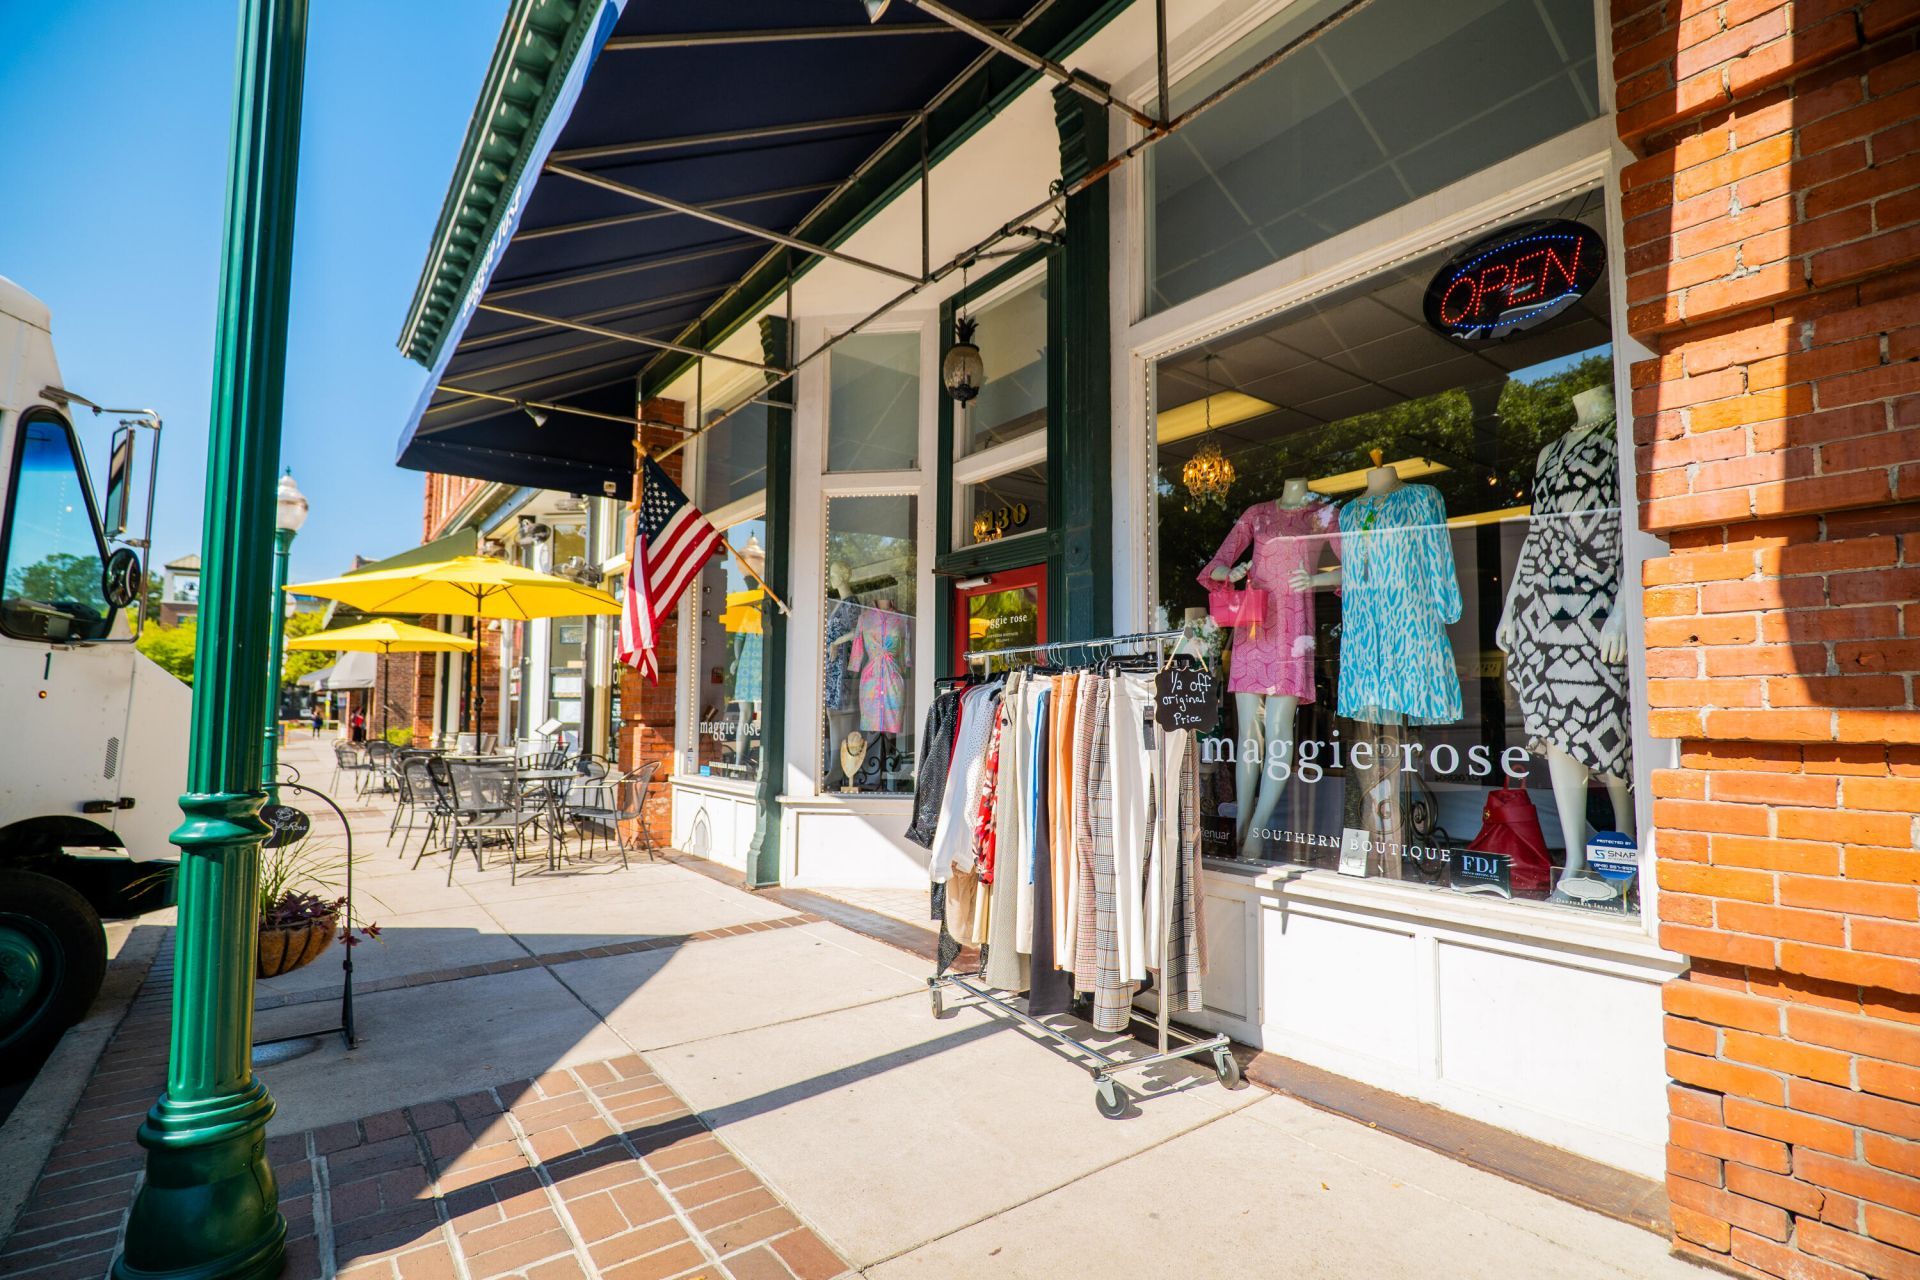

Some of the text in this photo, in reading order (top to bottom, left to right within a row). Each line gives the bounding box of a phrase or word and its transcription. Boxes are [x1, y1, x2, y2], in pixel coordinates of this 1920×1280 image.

[1441, 236, 1583, 324] OPEN
[1010, 614, 1028, 624] rose
[1190, 673, 1212, 691] off
[1162, 691, 1206, 712] original
[700, 717, 735, 741] maggie
[1173, 712, 1202, 726] Price
[1201, 730, 1531, 784] maggie rose
[1252, 827, 1451, 862] SOUTHERN BOUTIQUE
[1608, 850, 1635, 859] SNAP
[1462, 855, 1499, 875] FDJ
